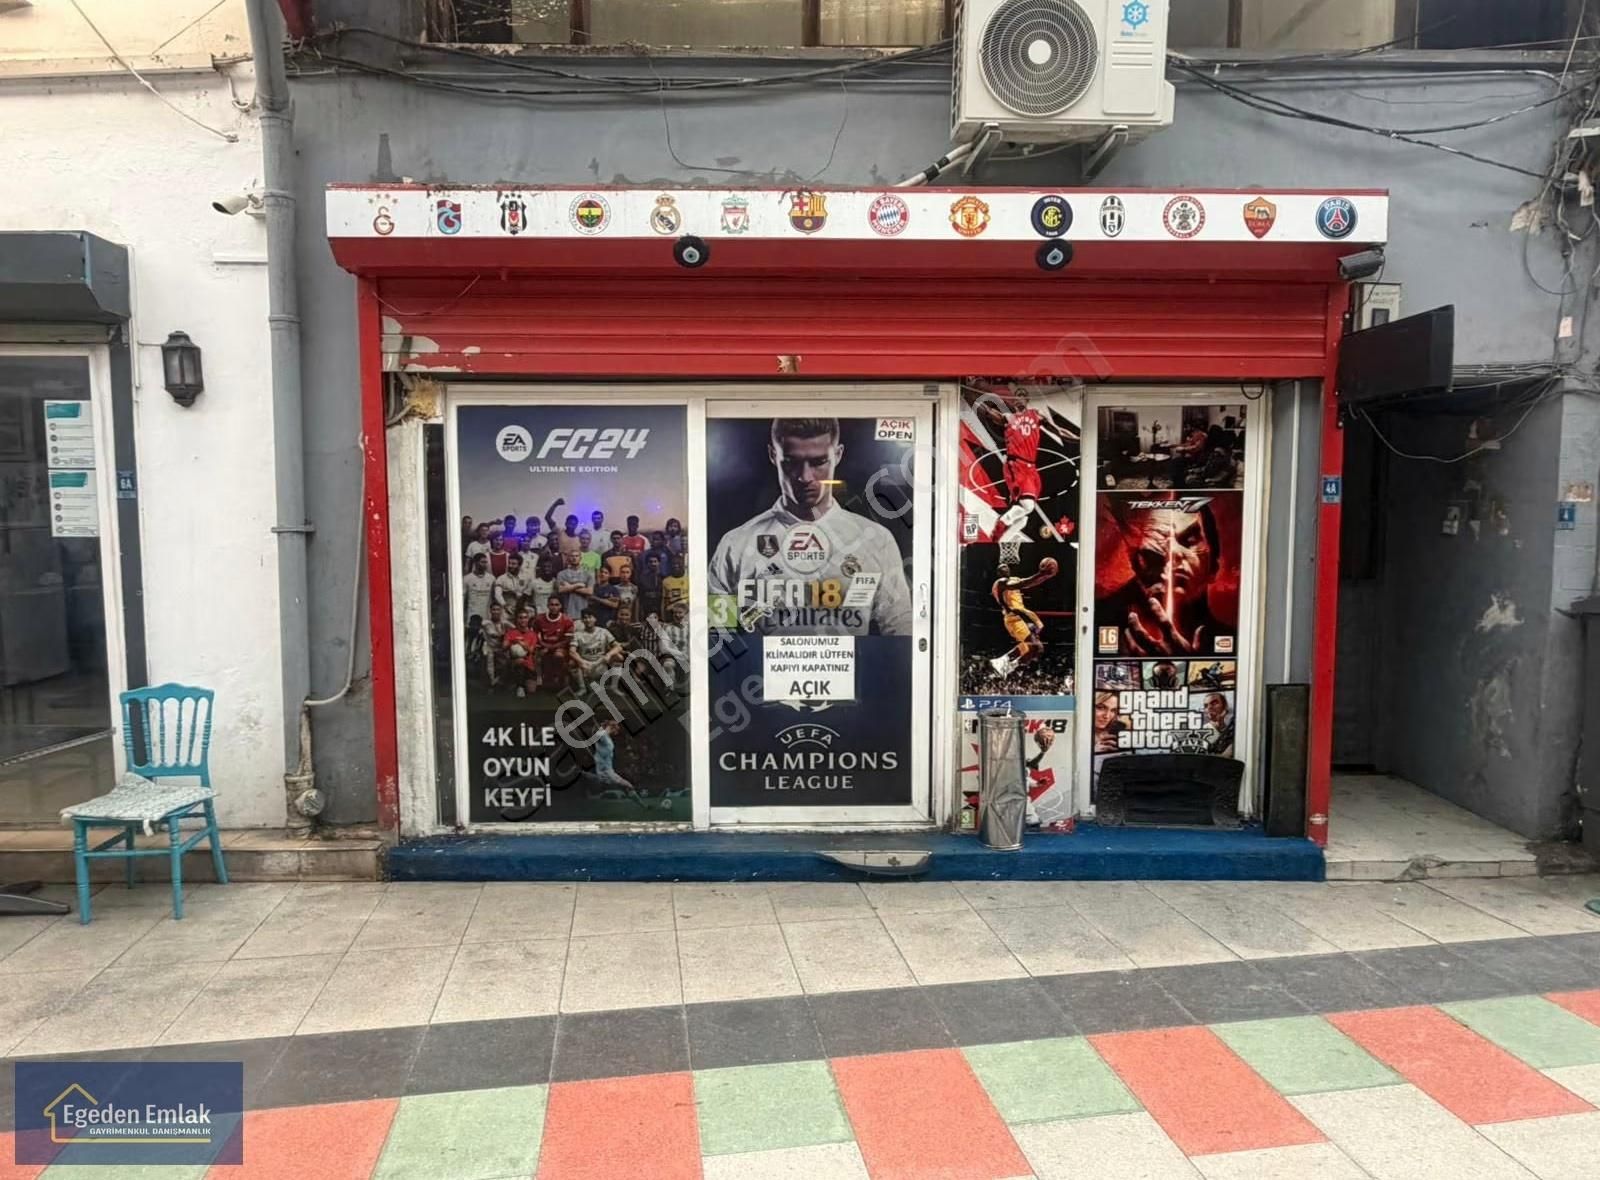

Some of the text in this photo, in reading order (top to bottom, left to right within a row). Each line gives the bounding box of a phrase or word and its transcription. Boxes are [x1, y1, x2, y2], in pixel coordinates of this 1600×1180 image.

[1324, 199, 1349, 210] PARIS
[879, 419, 910, 429] AÇIK
[1019, 424, 1031, 436] 10
[503, 433, 526, 445] EA
[878, 430, 912, 439] OPEN
[1325, 482, 1337, 494] 4A
[1127, 496, 1215, 513] TEKKEN 7
[788, 532, 824, 551] EA
[787, 551, 825, 561] SPORTS
[856, 577, 876, 585] FIFA
[738, 578, 843, 609] FIFA 18
[713, 597, 728, 624] 3
[780, 637, 840, 646] SALONUMUZ
[1100, 629, 1117, 644] 16
[820, 649, 854, 659] LÜTFEN
[770, 664, 850, 672] KAPIYI KAPATINIZ
[789, 680, 831, 698] AÇIK
[978, 699, 1012, 709] PS4
[482, 722, 556, 747] 4K İLE
[779, 727, 833, 746] UEFA
[483, 757, 551, 777] OYUN
[718, 751, 899, 771] CHAMPIONS
[764, 775, 854, 790] LEAGUE
[484, 783, 552, 807] KEYFİ
